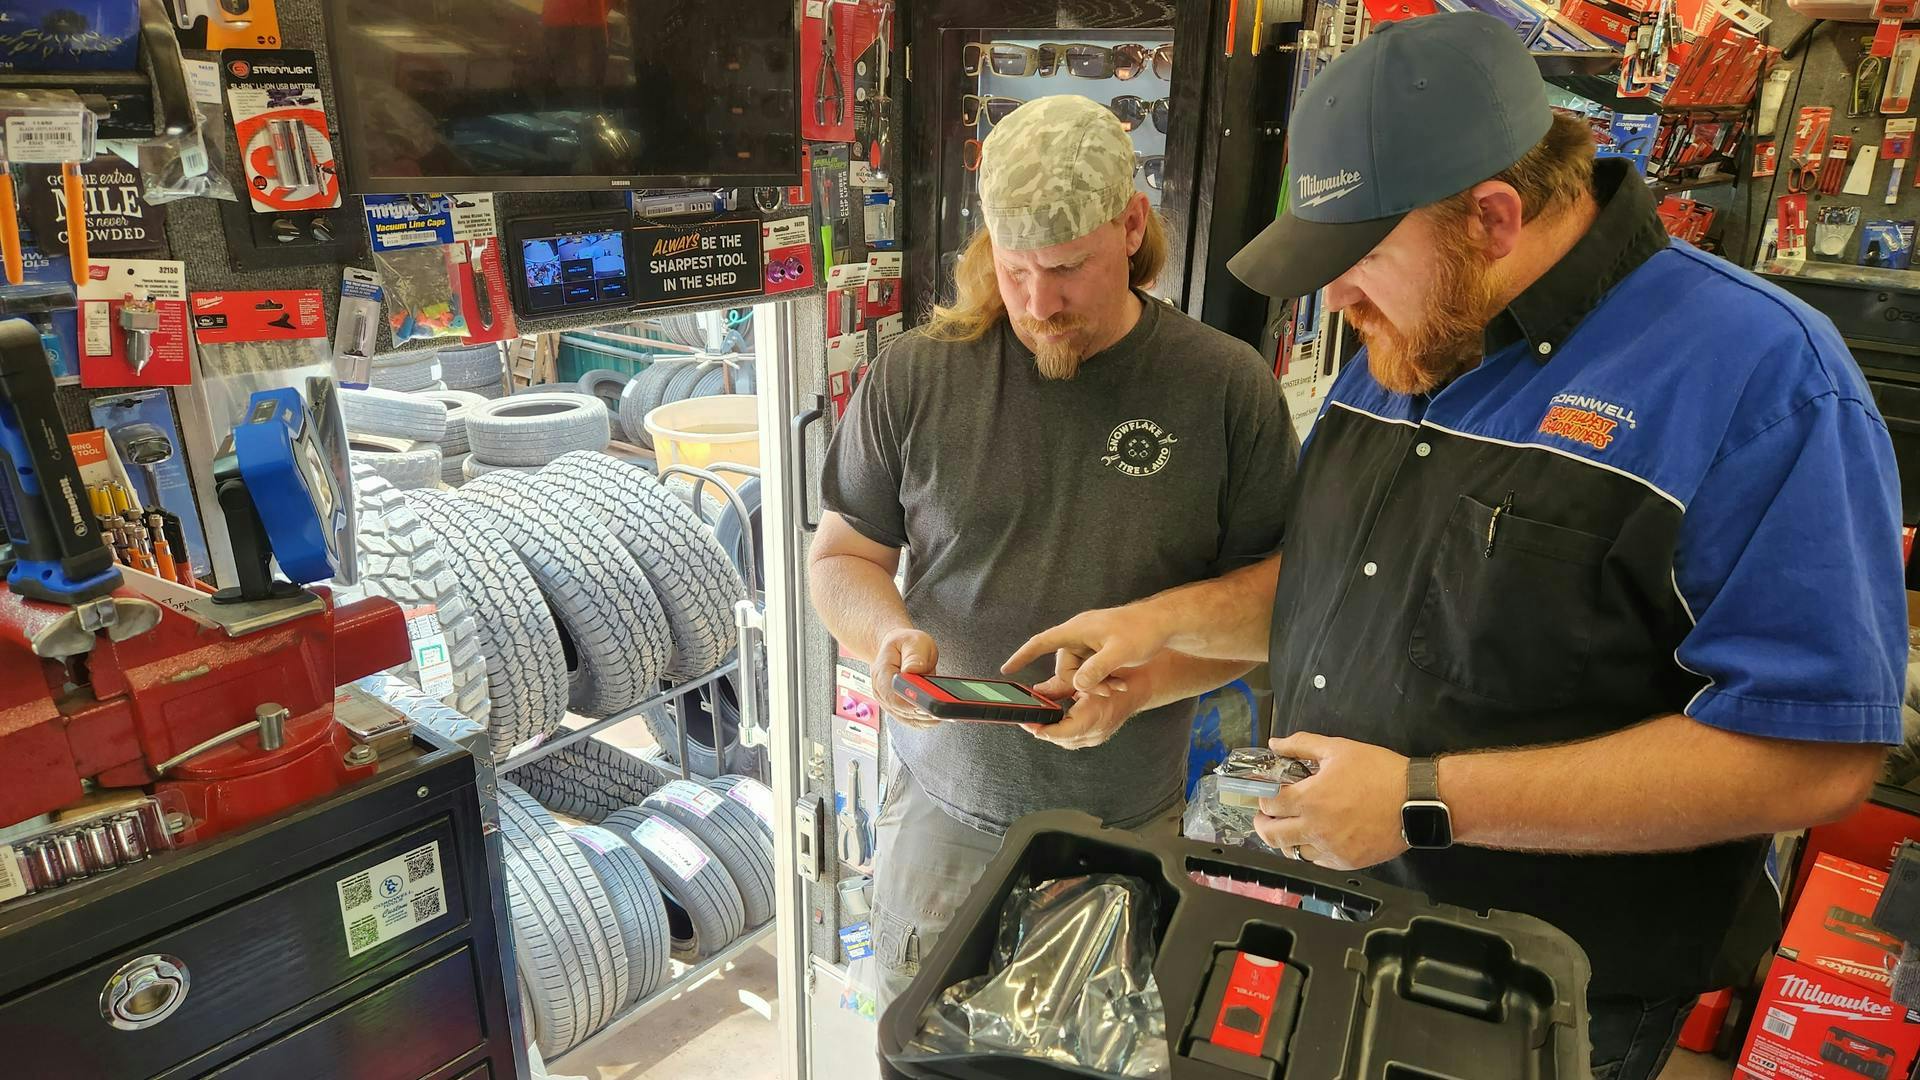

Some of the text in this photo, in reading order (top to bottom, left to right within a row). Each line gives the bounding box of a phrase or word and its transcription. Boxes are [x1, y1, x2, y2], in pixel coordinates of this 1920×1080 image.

[252, 66, 313, 75] STREAMLIGHT
[1615, 122, 1652, 130] CORNWELL
[99, 168, 136, 184] extra
[1297, 169, 1362, 200] Milwaukee
[96, 216, 129, 228] never
[375, 217, 446, 232] Vacuum Line Caps
[57, 227, 146, 244] COWDED
[652, 232, 742, 256] ALWAYS BE THE
[650, 252, 747, 274] SHARPEST TOOL
[663, 272, 737, 292] IN THE SHED
[1109, 421, 1163, 452] SNOWFLAKE
[79, 448, 101, 457] TOOL
[1118, 461, 1140, 474] TIRE
[1151, 447, 1169, 470] AUTO
[1778, 974, 1892, 1017] Milwaukee
